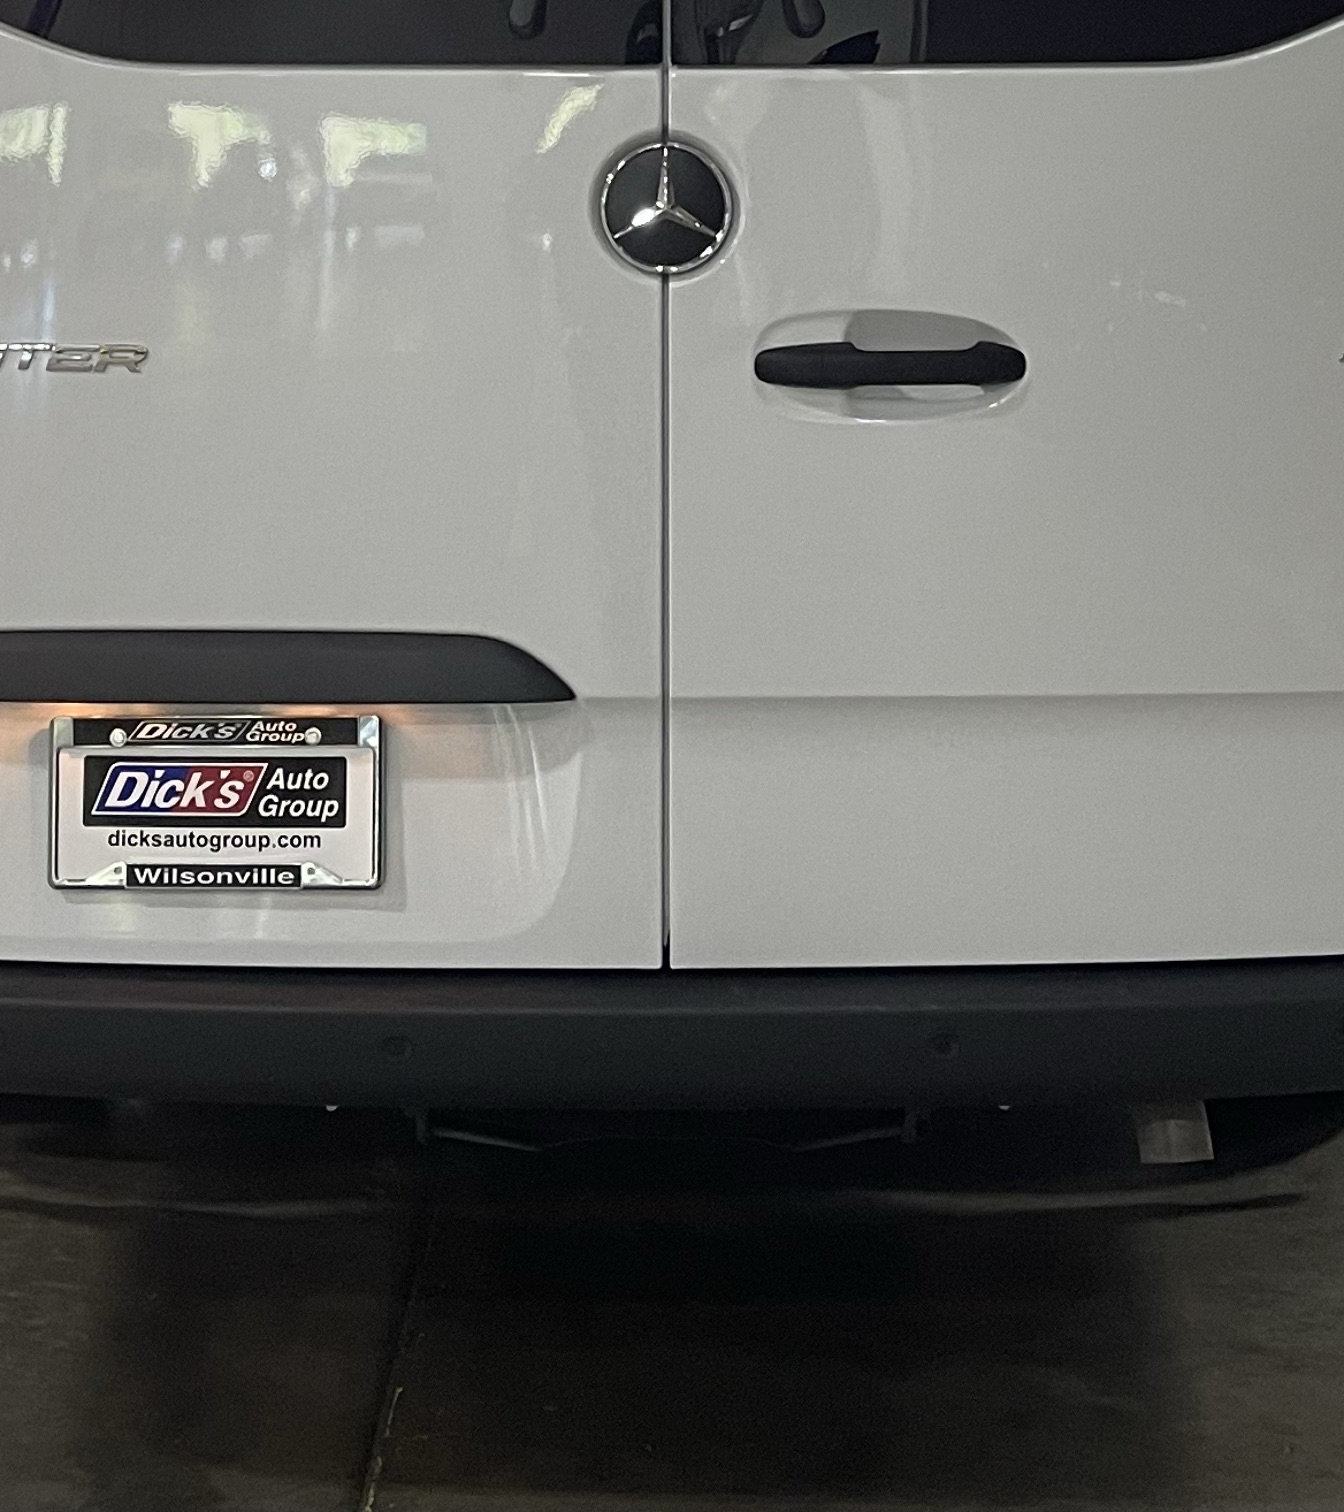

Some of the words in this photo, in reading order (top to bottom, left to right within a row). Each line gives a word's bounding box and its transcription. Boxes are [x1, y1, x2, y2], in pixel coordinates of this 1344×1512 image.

[136, 722, 238, 740] Dick's
[254, 720, 297, 732] Auto
[245, 731, 305, 744] Group
[104, 769, 245, 810] Dick's
[266, 767, 330, 790] Auto
[258, 794, 339, 823] Group
[107, 830, 322, 852] dicksautogroup.com
[133, 867, 296, 885] Wilsonville
